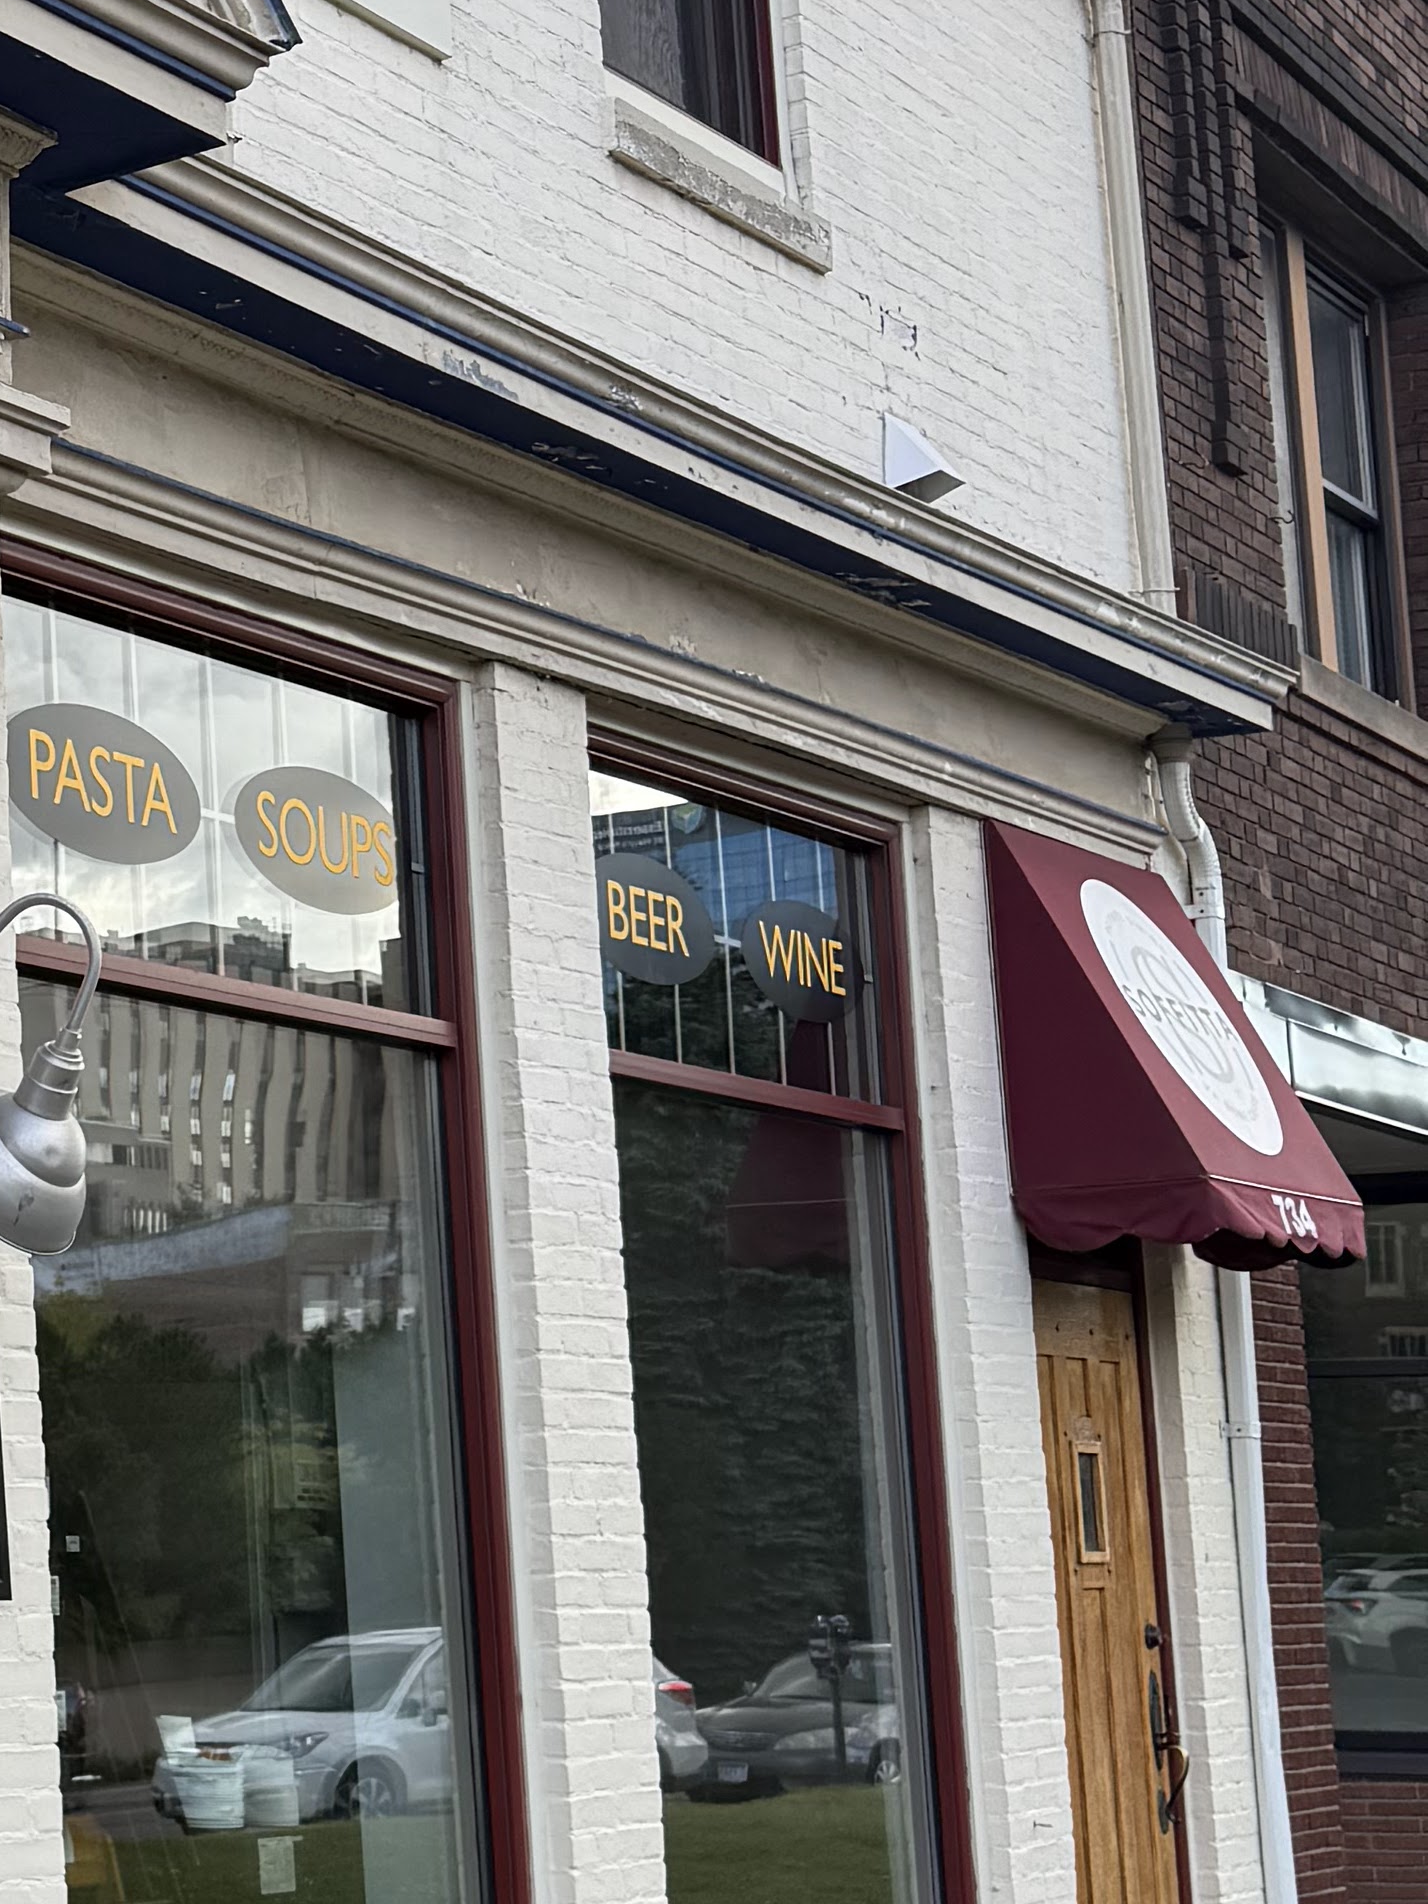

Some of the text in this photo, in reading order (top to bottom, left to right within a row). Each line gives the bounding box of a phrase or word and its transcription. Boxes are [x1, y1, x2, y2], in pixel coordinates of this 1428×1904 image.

[29, 729, 178, 835] PASTA
[256, 791, 395, 887] SOUPS
[607, 879, 690, 958] BEER
[759, 920, 847, 997] WINE
[1122, 984, 1239, 1042] SOFFITTA
[1271, 1194, 1319, 1239] 734
